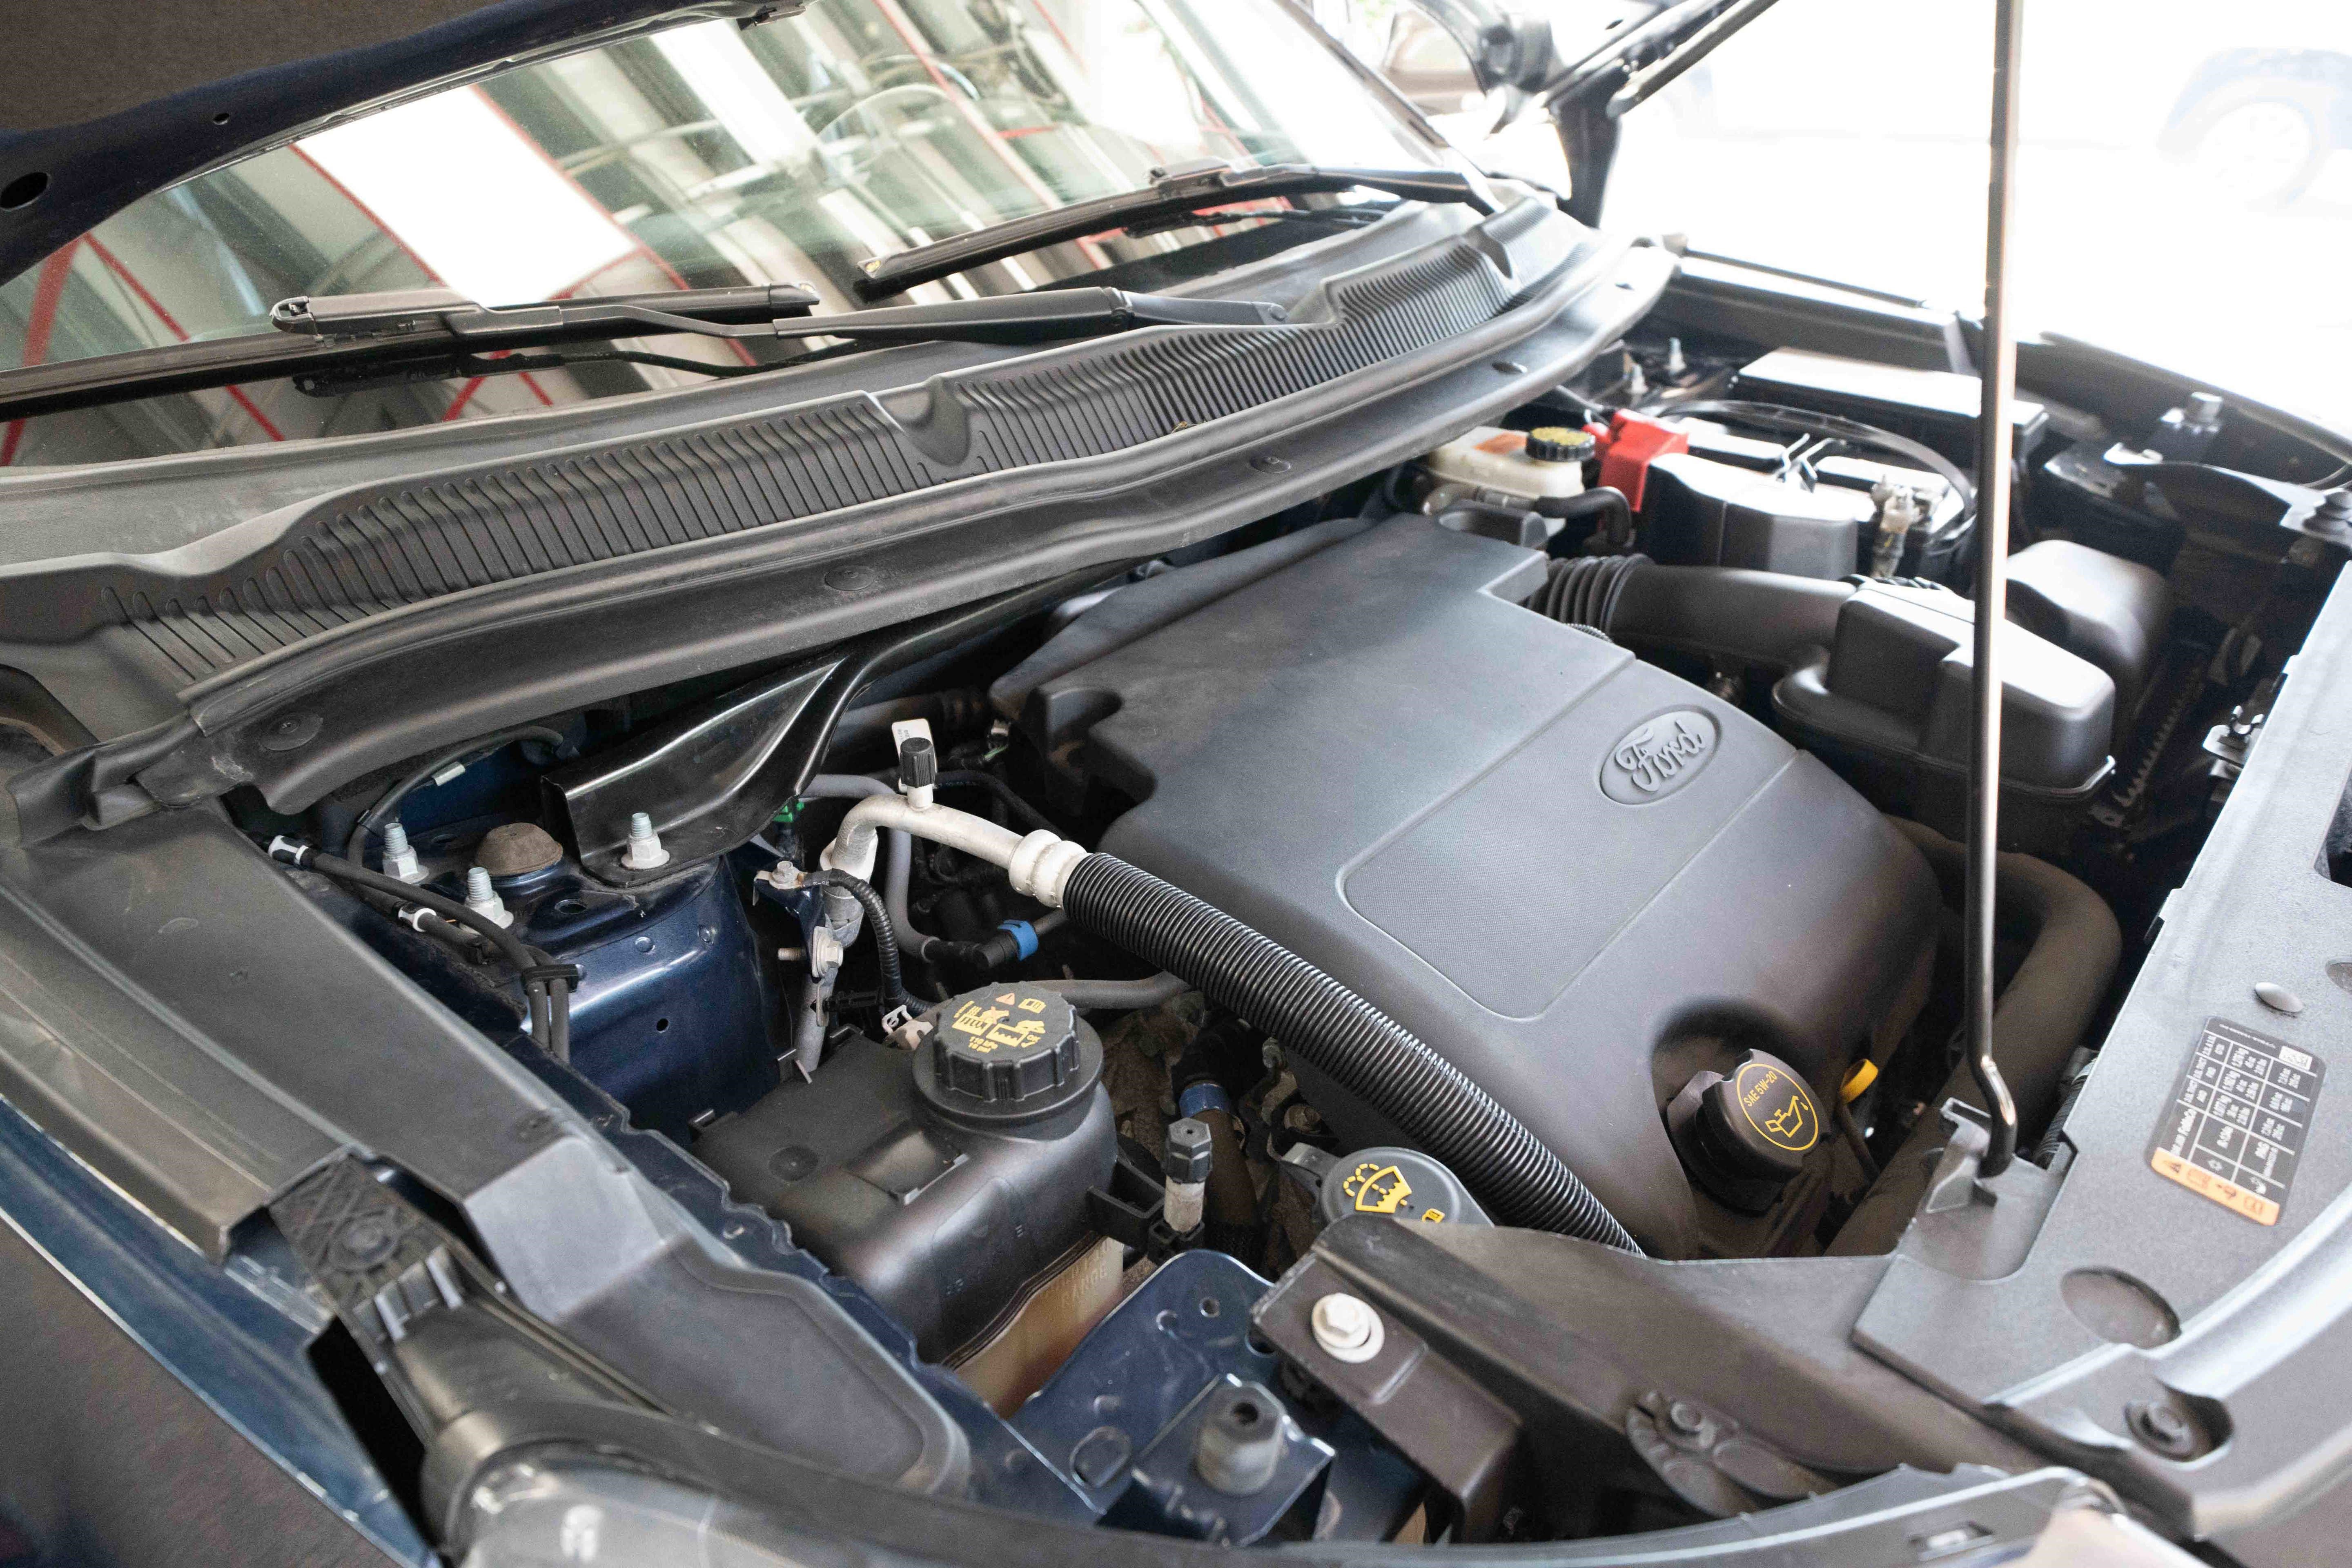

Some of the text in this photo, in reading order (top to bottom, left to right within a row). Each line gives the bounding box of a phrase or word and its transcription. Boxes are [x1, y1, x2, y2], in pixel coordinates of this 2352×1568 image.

[1615, 719, 1706, 792] Ford
[1743, 1071, 1777, 1107] SAE 5W-20
